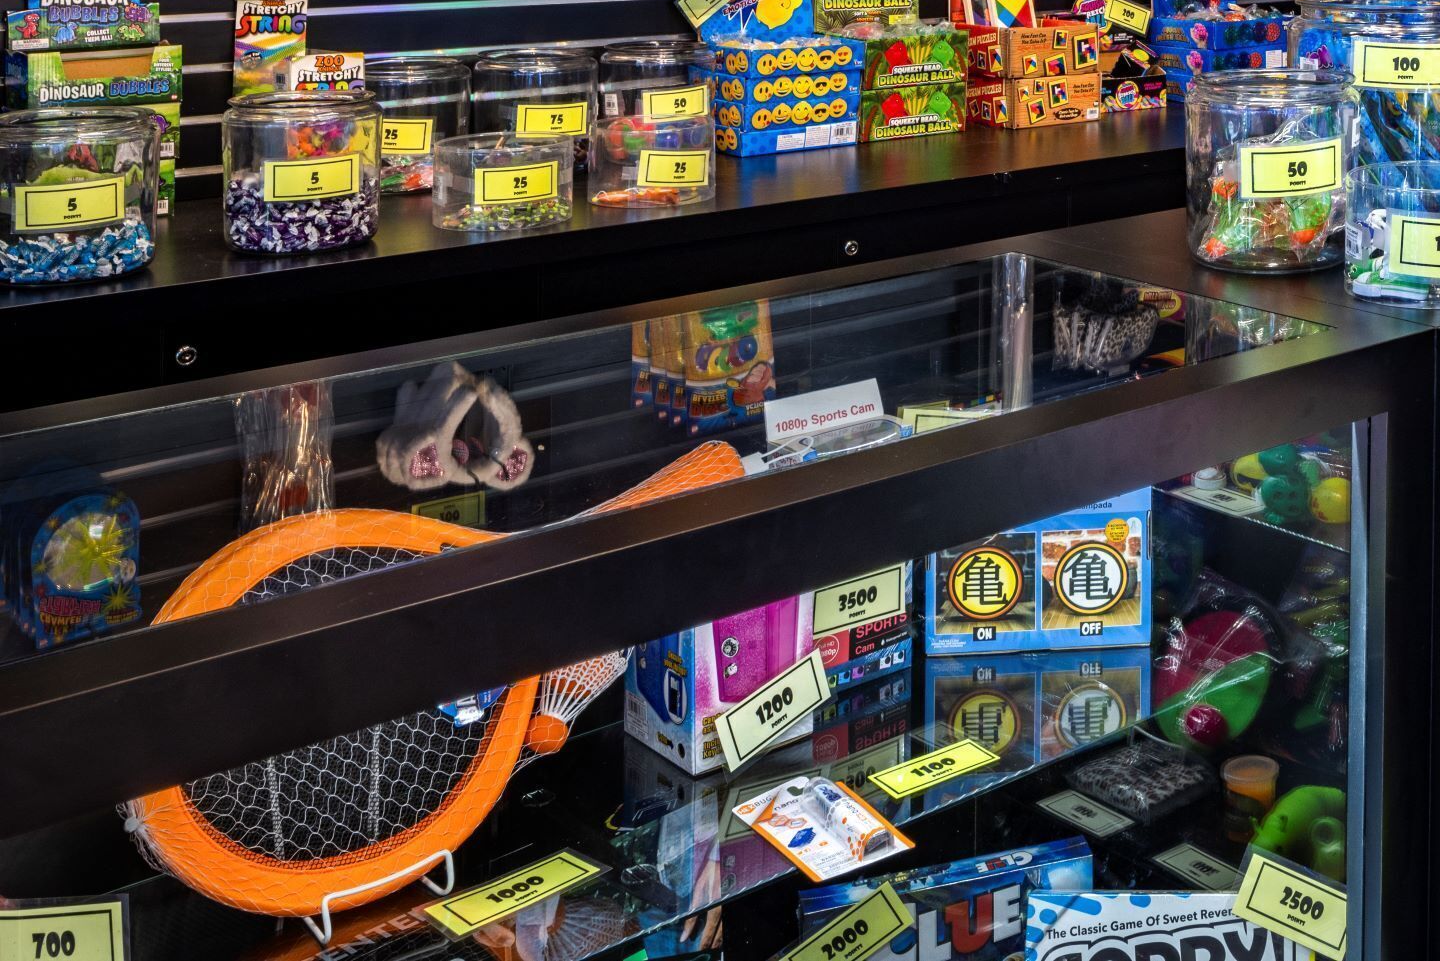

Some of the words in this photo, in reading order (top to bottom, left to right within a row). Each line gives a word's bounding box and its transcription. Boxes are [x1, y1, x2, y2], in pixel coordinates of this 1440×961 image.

[48, 6, 119, 23] BUBBLES
[243, 2, 304, 16] STRETCHY
[236, 14, 306, 38] STRING
[315, 55, 344, 67] ZOO
[1392, 56, 1419, 72] 100
[298, 66, 360, 82] STRETCHY
[878, 74, 924, 86] DINOSAUR
[926, 70, 954, 80] BALL
[39, 84, 104, 101] DINOSAUR
[110, 79, 169, 96] BUBBLES
[674, 98, 687, 108] 50
[550, 114, 563, 124] 75
[384, 129, 398, 139] 25
[674, 162, 686, 173] 25
[1288, 162, 1307, 177] 50
[311, 172, 319, 184] 5
[513, 177, 527, 188] 25
[68, 198, 77, 211] 5
[775, 418, 808, 434] 1080p
[811, 409, 848, 425] Sports
[850, 402, 875, 416] Cam
[962, 555, 1009, 605] 亀
[1063, 551, 1114, 601] 亀
[838, 587, 877, 612] 3500
[848, 609, 865, 618] POINTS
[857, 612, 907, 639] SPORTS
[1082, 623, 1101, 634] OFF
[976, 628, 993, 640] ON
[855, 642, 875, 652] Cam
[756, 688, 795, 722] 1200
[910, 757, 955, 778] 1100
[487, 876, 544, 904] 1000
[514, 890, 538, 901] POINTS
[1279, 885, 1324, 920] 2500
[1046, 928, 1067, 940] The
[1070, 924, 1108, 937] Classic
[1110, 920, 1143, 933] Game
[1146, 915, 1160, 927] Of
[1162, 912, 1198, 925] Sweet
[32, 931, 75, 959] 700
[821, 919, 868, 960] 2000
